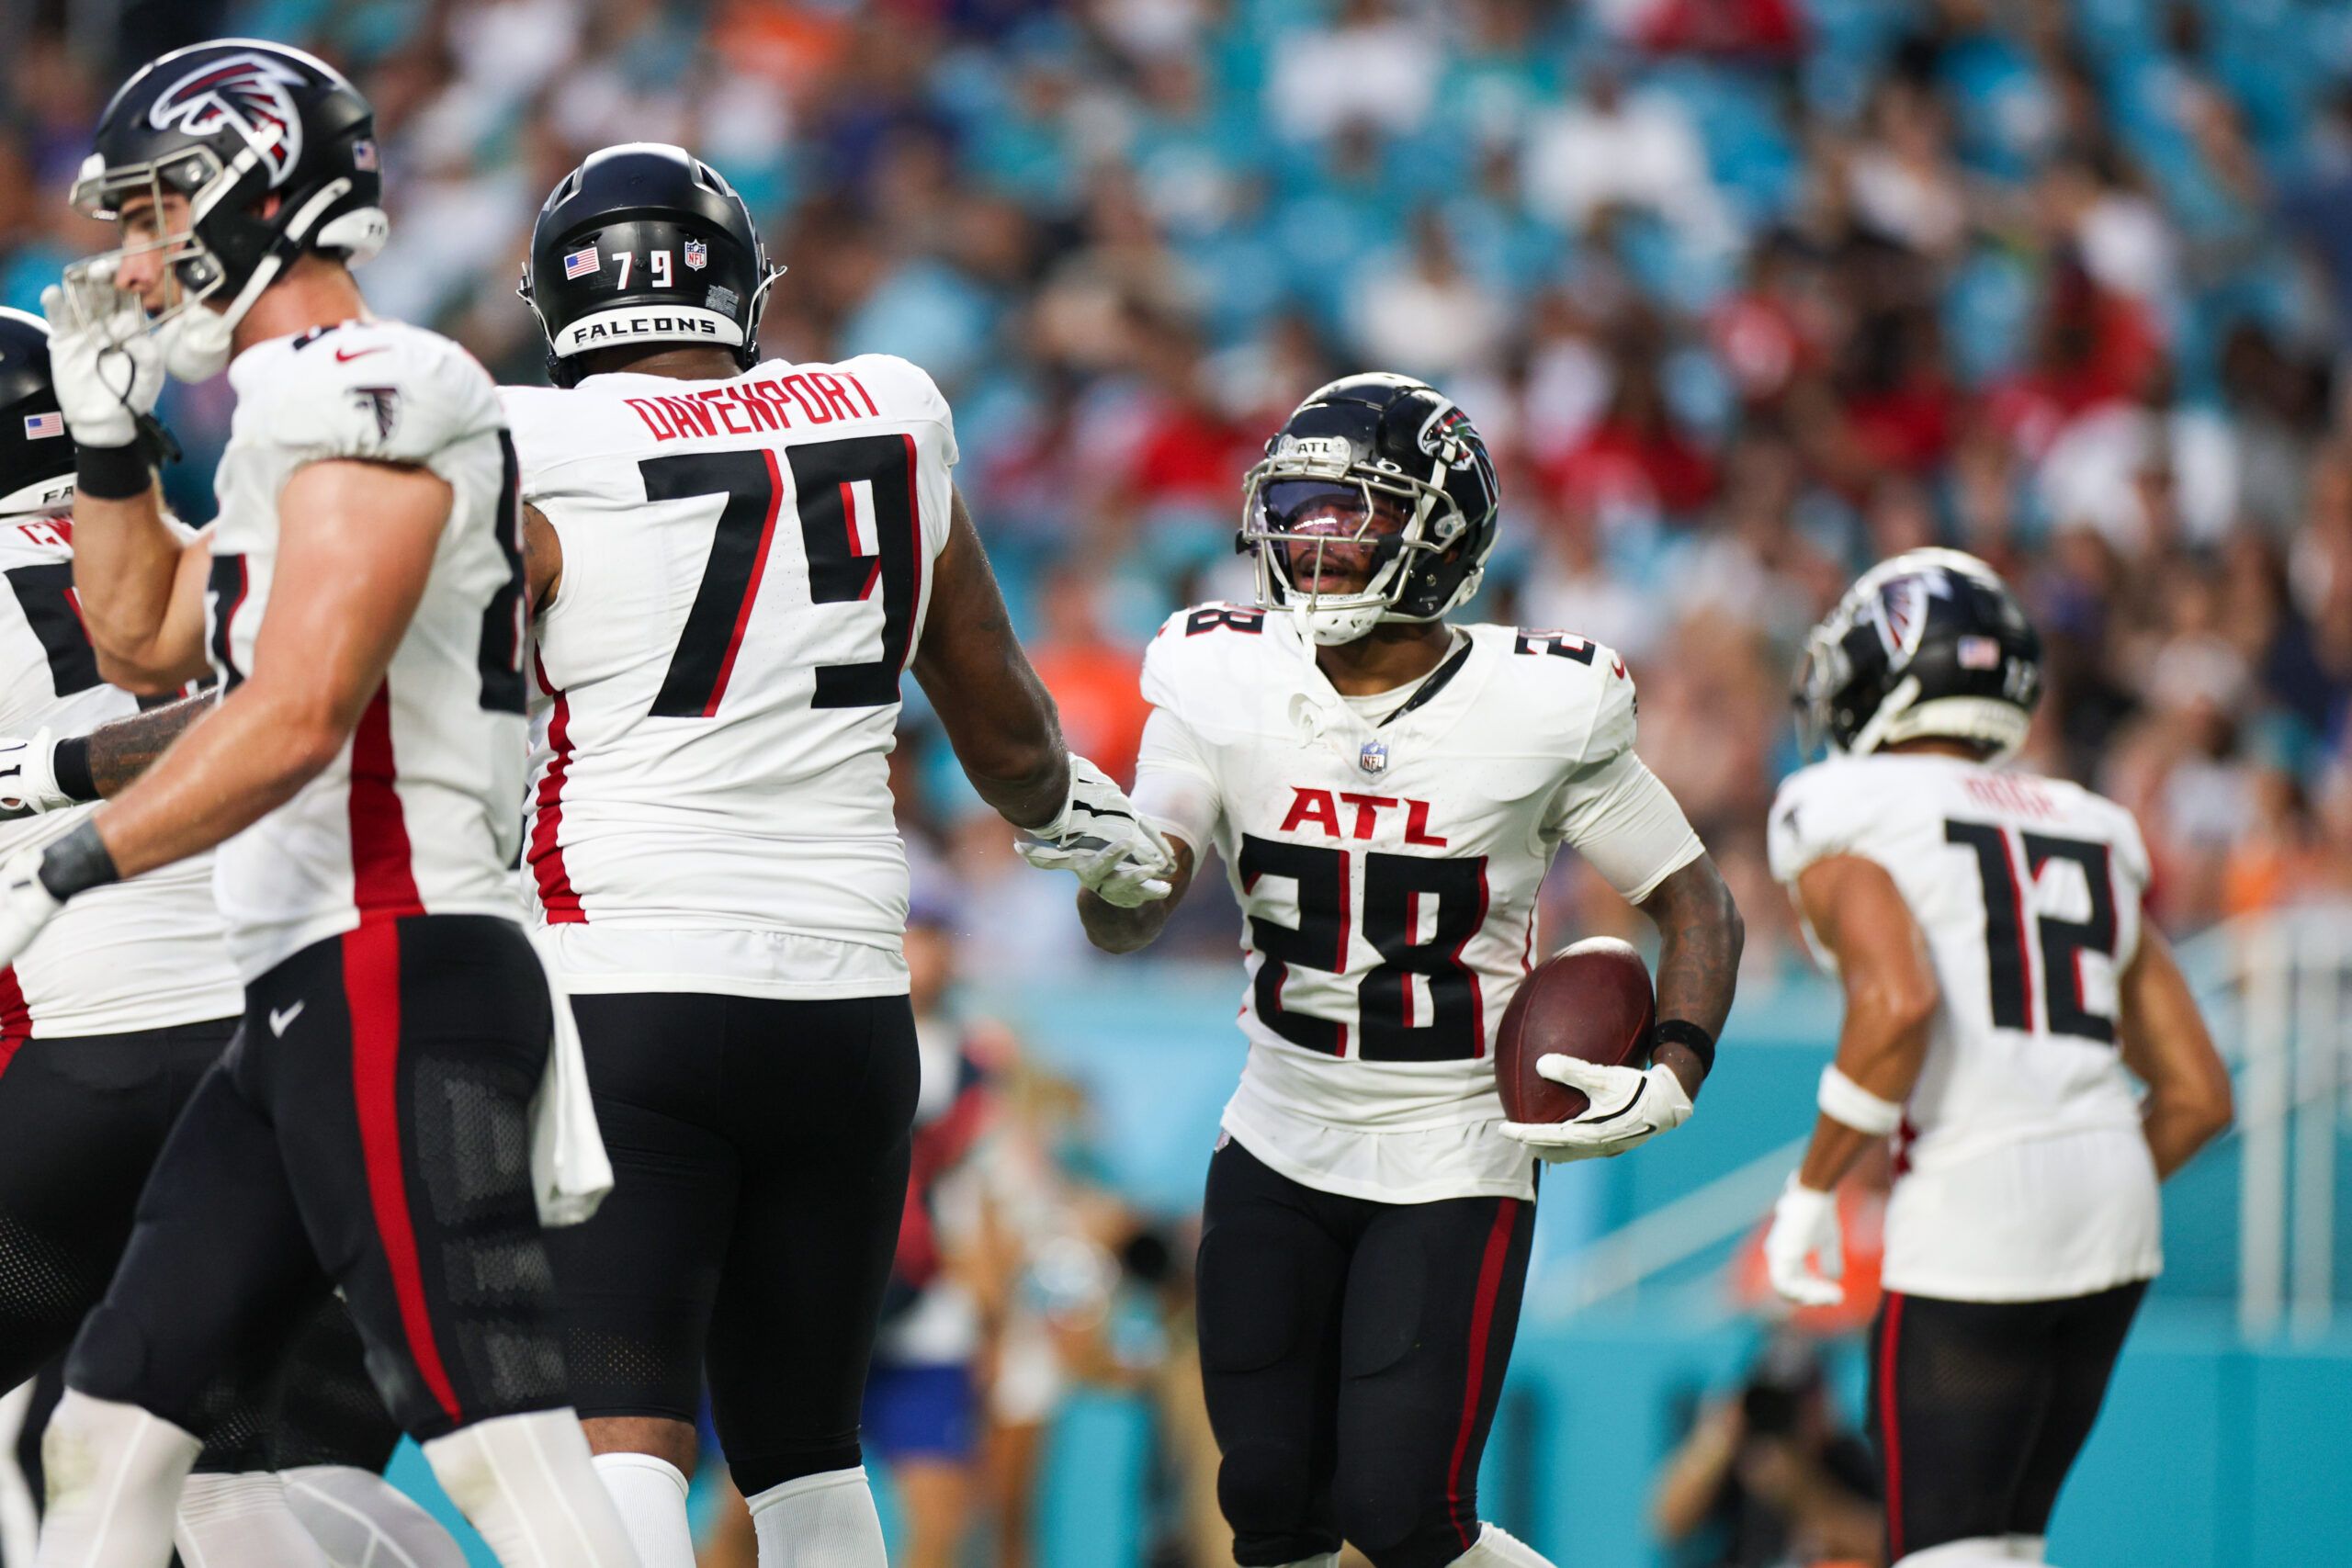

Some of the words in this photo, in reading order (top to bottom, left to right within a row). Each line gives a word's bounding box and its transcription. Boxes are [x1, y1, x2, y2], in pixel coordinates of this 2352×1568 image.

[612, 250, 673, 290] 79
[688, 253, 705, 265] NFL
[573, 318, 716, 344] FALCONS
[624, 371, 880, 441] DAVENPORT
[1297, 442, 1330, 454] ATL
[638, 434, 922, 717] 79
[1185, 603, 1267, 637] 8
[1364, 755, 1383, 771] NFL
[1280, 786, 1447, 847] ATL
[1238, 832, 1489, 1062] 28
[1943, 818, 2118, 1046] 12
